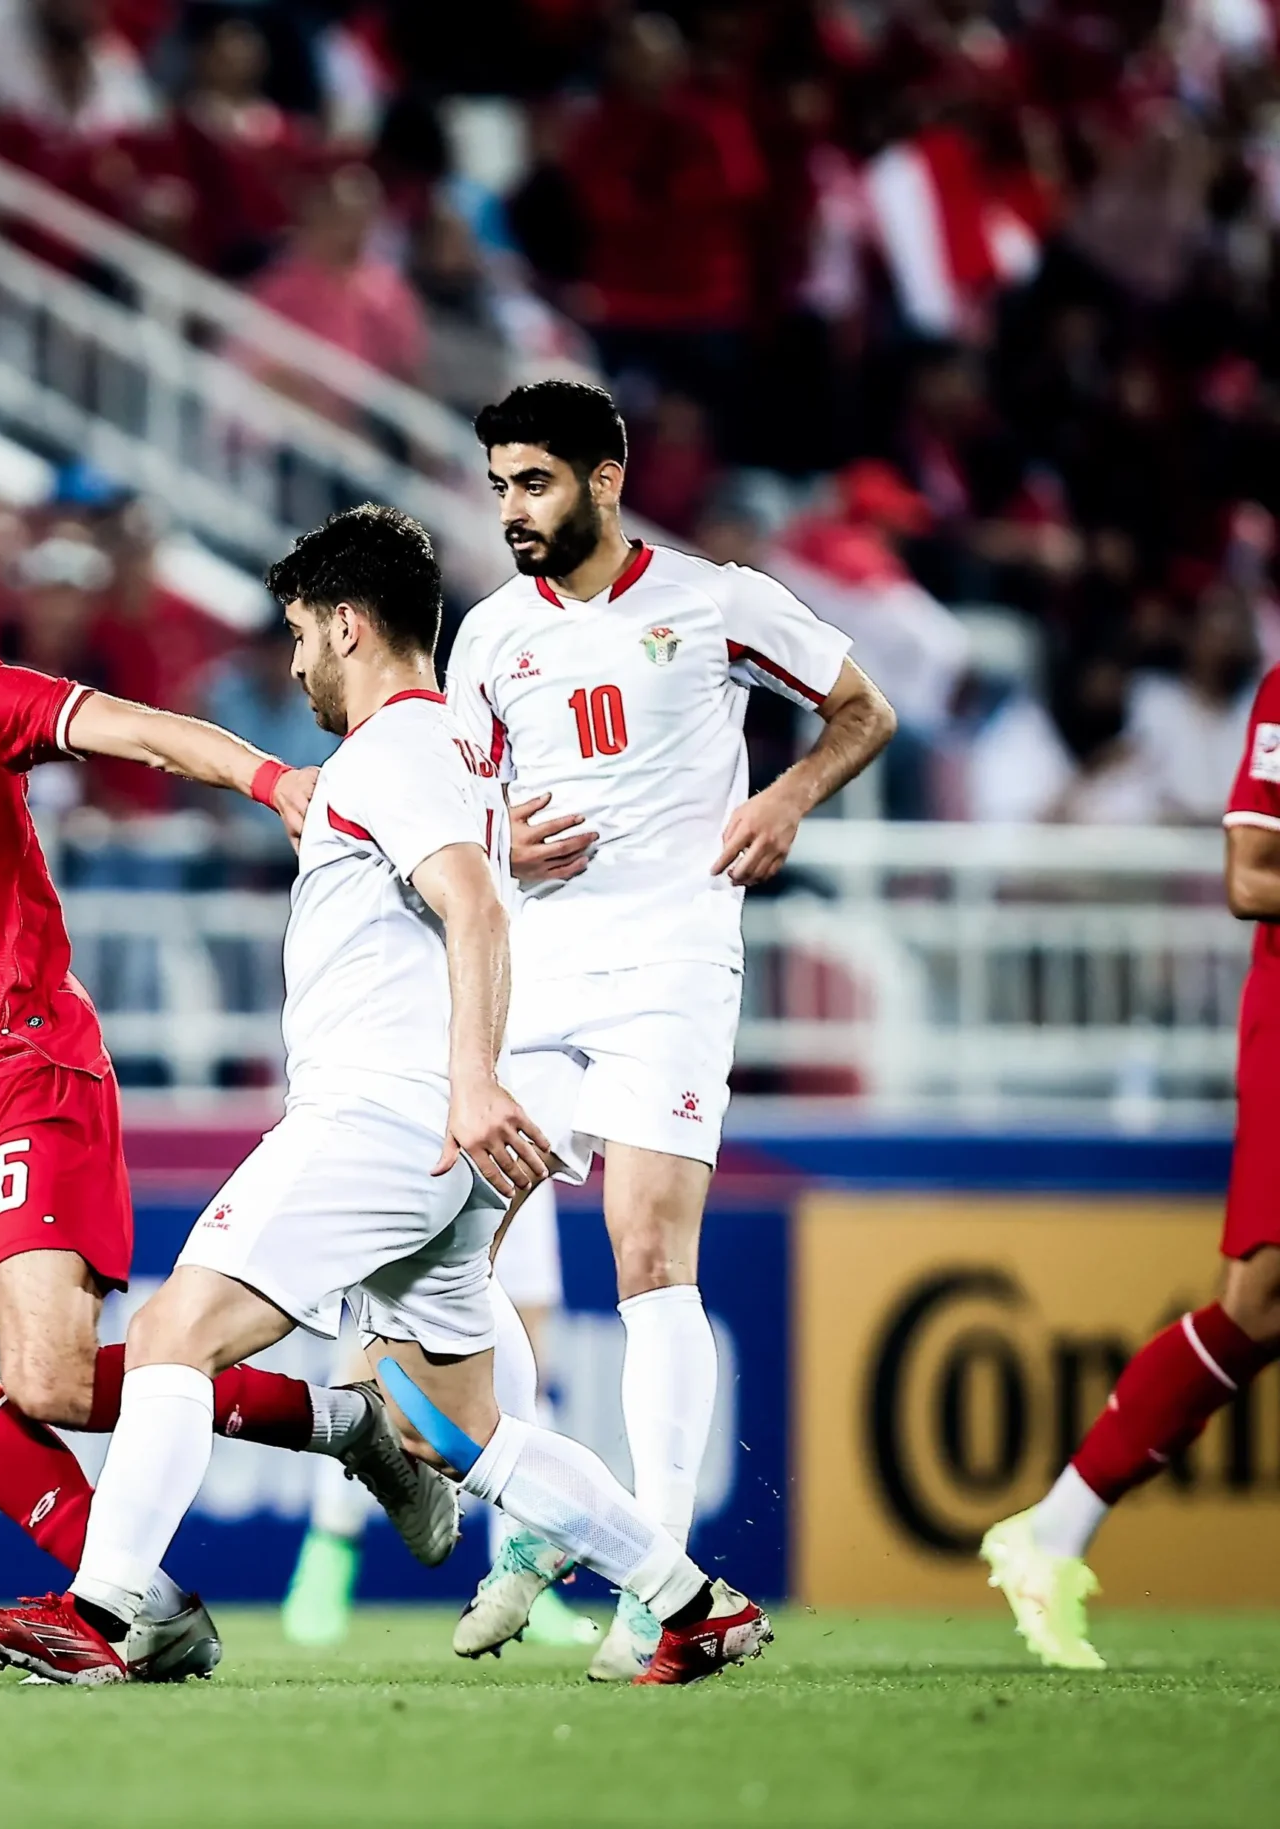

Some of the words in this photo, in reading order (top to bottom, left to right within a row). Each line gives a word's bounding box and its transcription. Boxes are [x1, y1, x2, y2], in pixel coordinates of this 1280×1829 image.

[510, 668, 542, 680] KELME
[568, 684, 628, 759] 10
[672, 1109, 703, 1123] KELME
